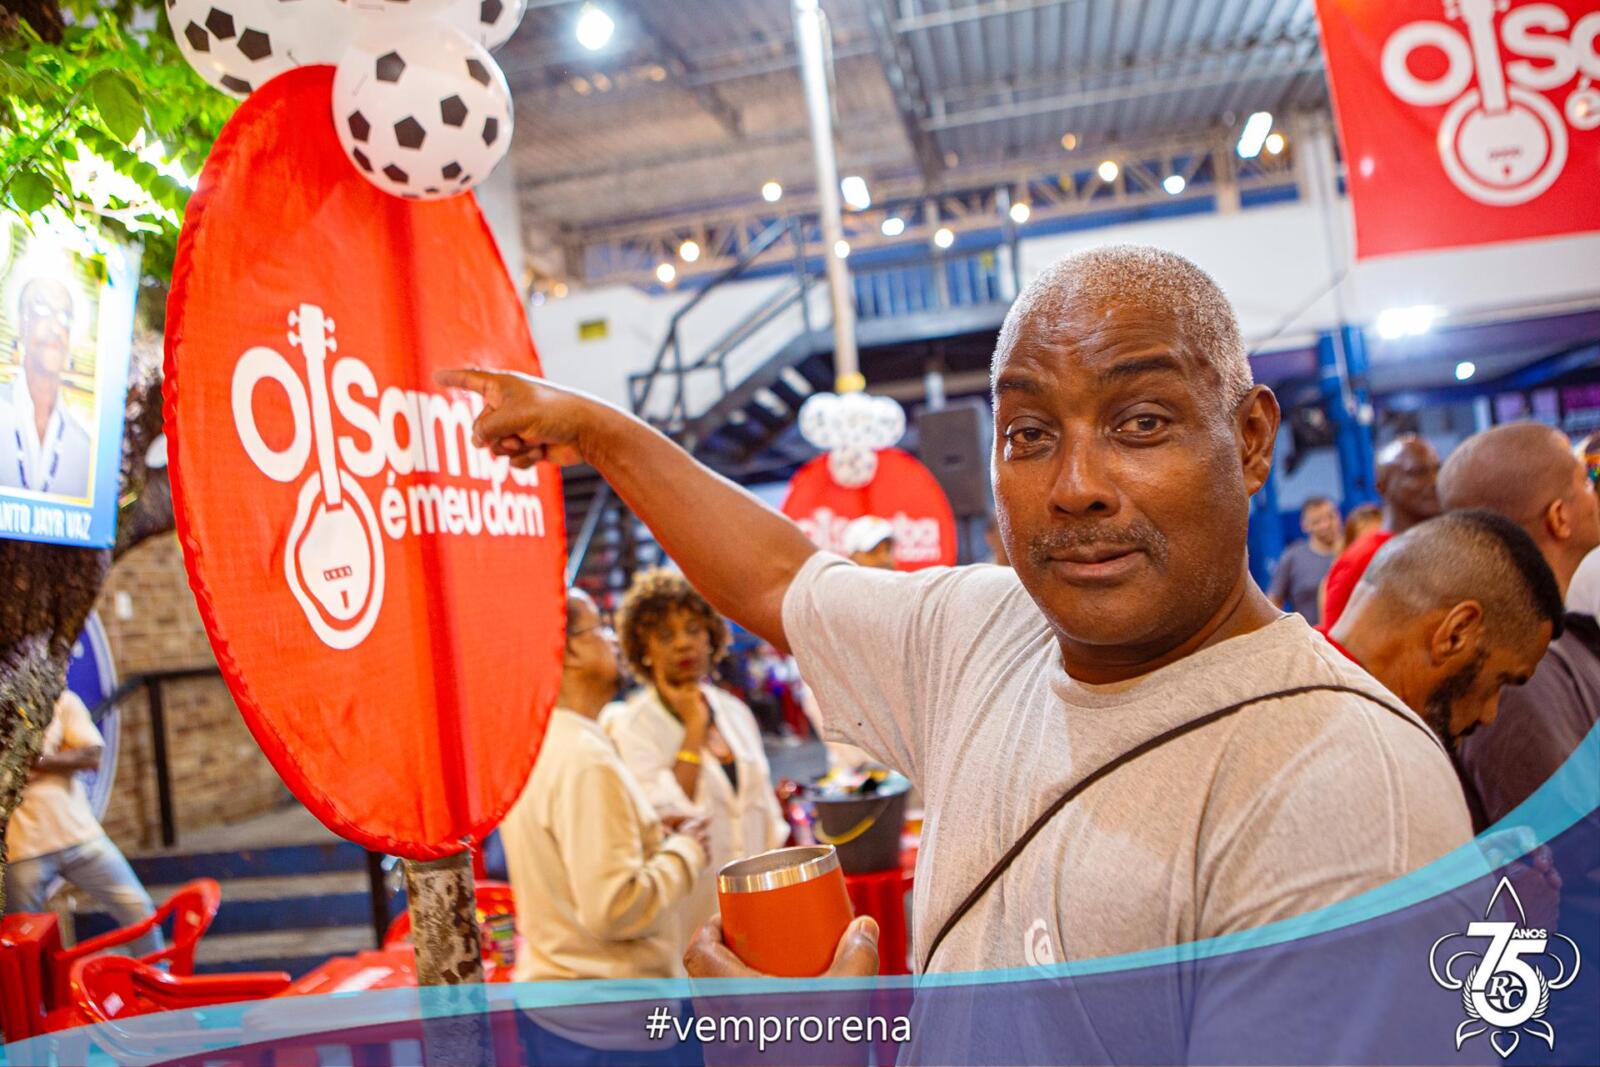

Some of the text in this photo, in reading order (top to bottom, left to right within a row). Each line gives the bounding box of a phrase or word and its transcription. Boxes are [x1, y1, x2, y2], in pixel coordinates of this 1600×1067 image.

[65, 510, 92, 541] VAZ
[379, 469, 546, 540] é meu dom
